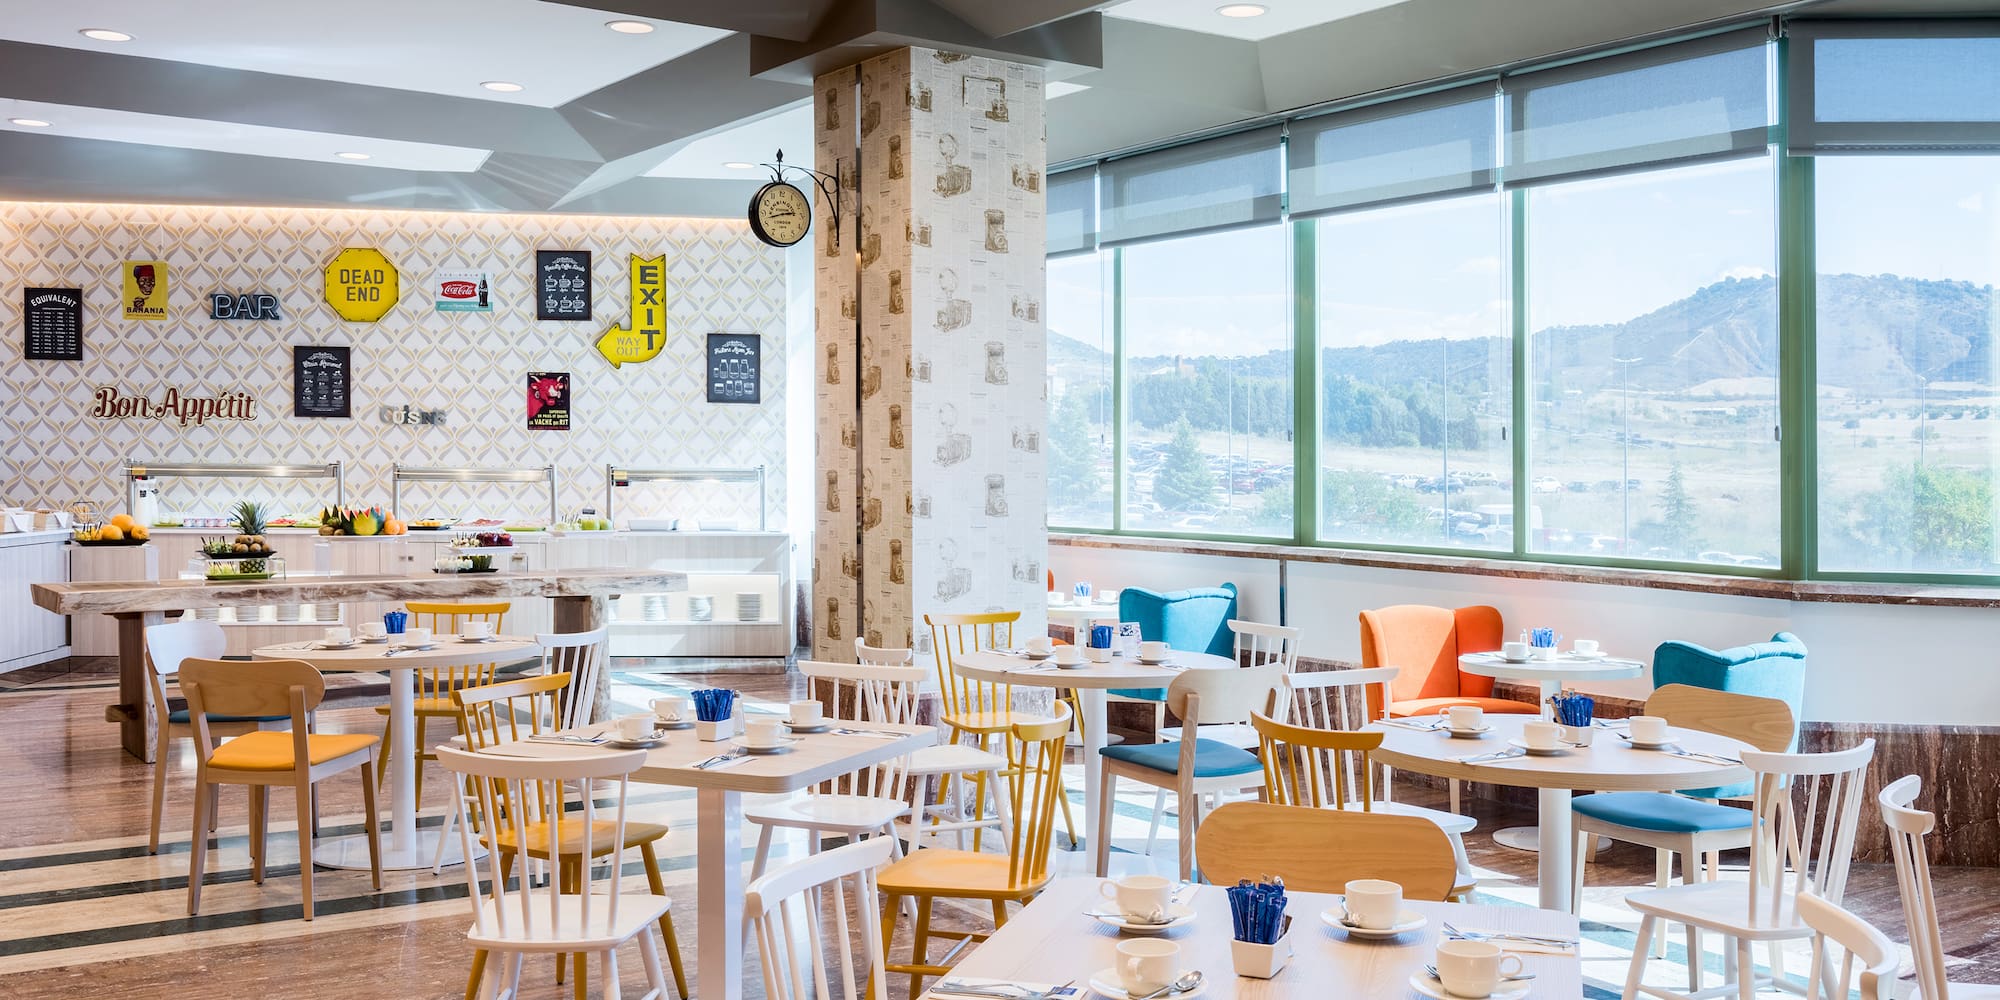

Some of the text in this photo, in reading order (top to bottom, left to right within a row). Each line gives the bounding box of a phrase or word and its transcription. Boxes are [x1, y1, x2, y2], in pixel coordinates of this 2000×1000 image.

[340, 269, 384, 284] DEAD
[30, 294, 77, 308] EQUIVALENT
[346, 287, 380, 302] END
[210, 294, 280, 320] BAR
[640, 265, 660, 350] EXIT
[616, 337, 640, 346] WAY
[616, 347, 640, 356] OUT
[92, 386, 257, 426] Bon Appétit
